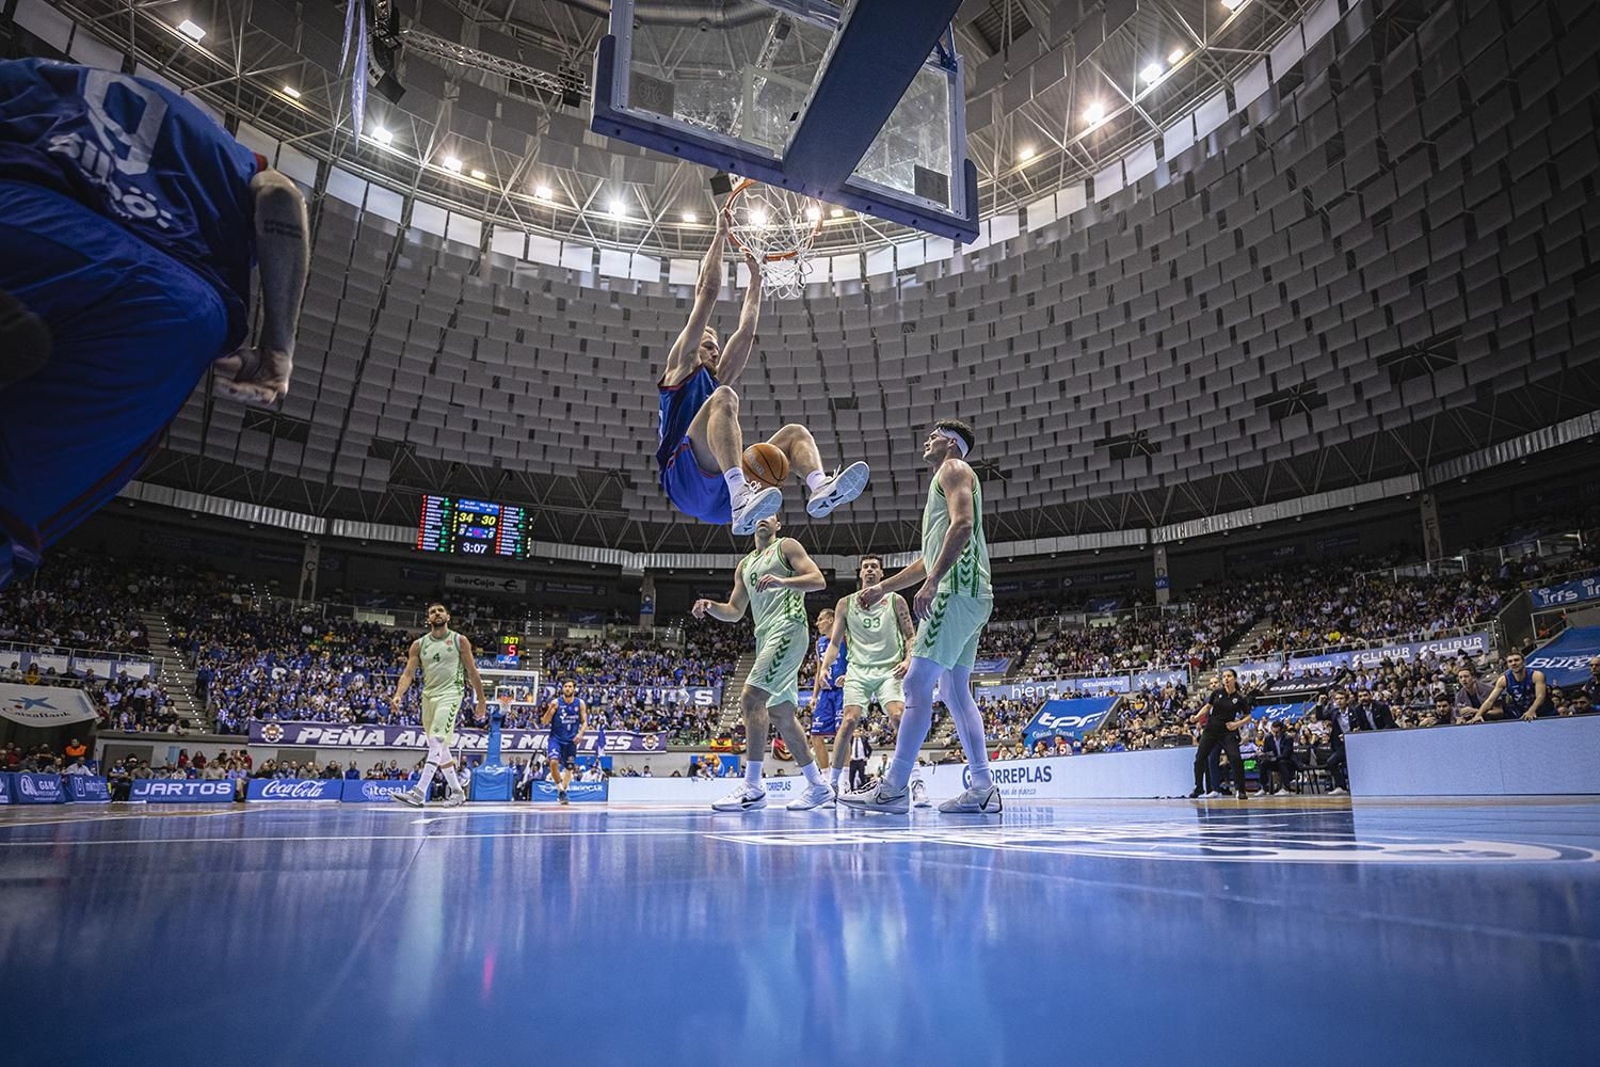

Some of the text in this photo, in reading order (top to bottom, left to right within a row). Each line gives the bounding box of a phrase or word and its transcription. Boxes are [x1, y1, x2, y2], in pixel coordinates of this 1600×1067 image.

[459, 512, 496, 526] 34 30
[463, 542, 487, 554] 3:07
[750, 572, 758, 587] 8
[863, 617, 880, 629] 93
[509, 645, 516, 656] 5
[1428, 637, 1482, 653] CLIBUR
[433, 652, 440, 662] 4
[296, 726, 385, 746] PEÑA
[133, 782, 231, 795] JARTOS
